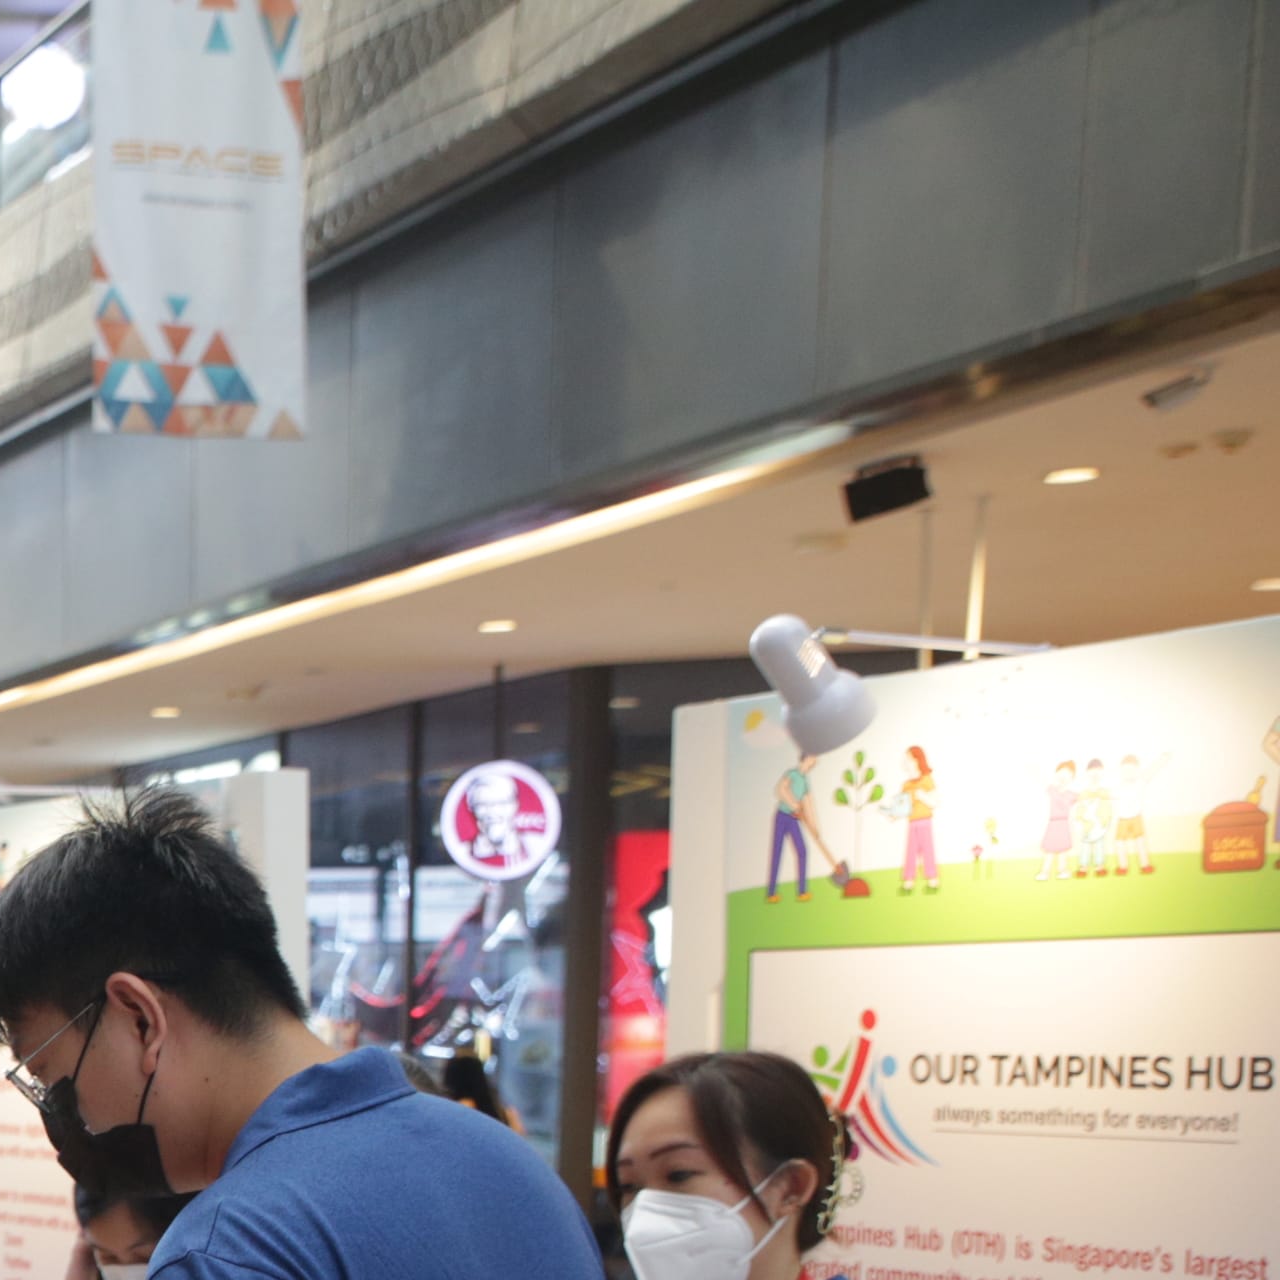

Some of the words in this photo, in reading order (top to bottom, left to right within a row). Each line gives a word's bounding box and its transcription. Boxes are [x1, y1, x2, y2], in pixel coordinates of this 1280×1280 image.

[112, 140, 284, 177] SPACE
[910, 1053, 980, 1086] OUR
[989, 1054, 1173, 1091] TAMPINES
[1184, 1056, 1274, 1092] HUB
[933, 1106, 992, 1126] always
[997, 1108, 1098, 1132] something
[1102, 1109, 1131, 1128] for
[1135, 1112, 1240, 1136] everyone!
[904, 1224, 942, 1251] Hub
[951, 1230, 1007, 1262] (OTH)
[1016, 1236, 1033, 1260] is
[1042, 1238, 1173, 1274] Singapore's
